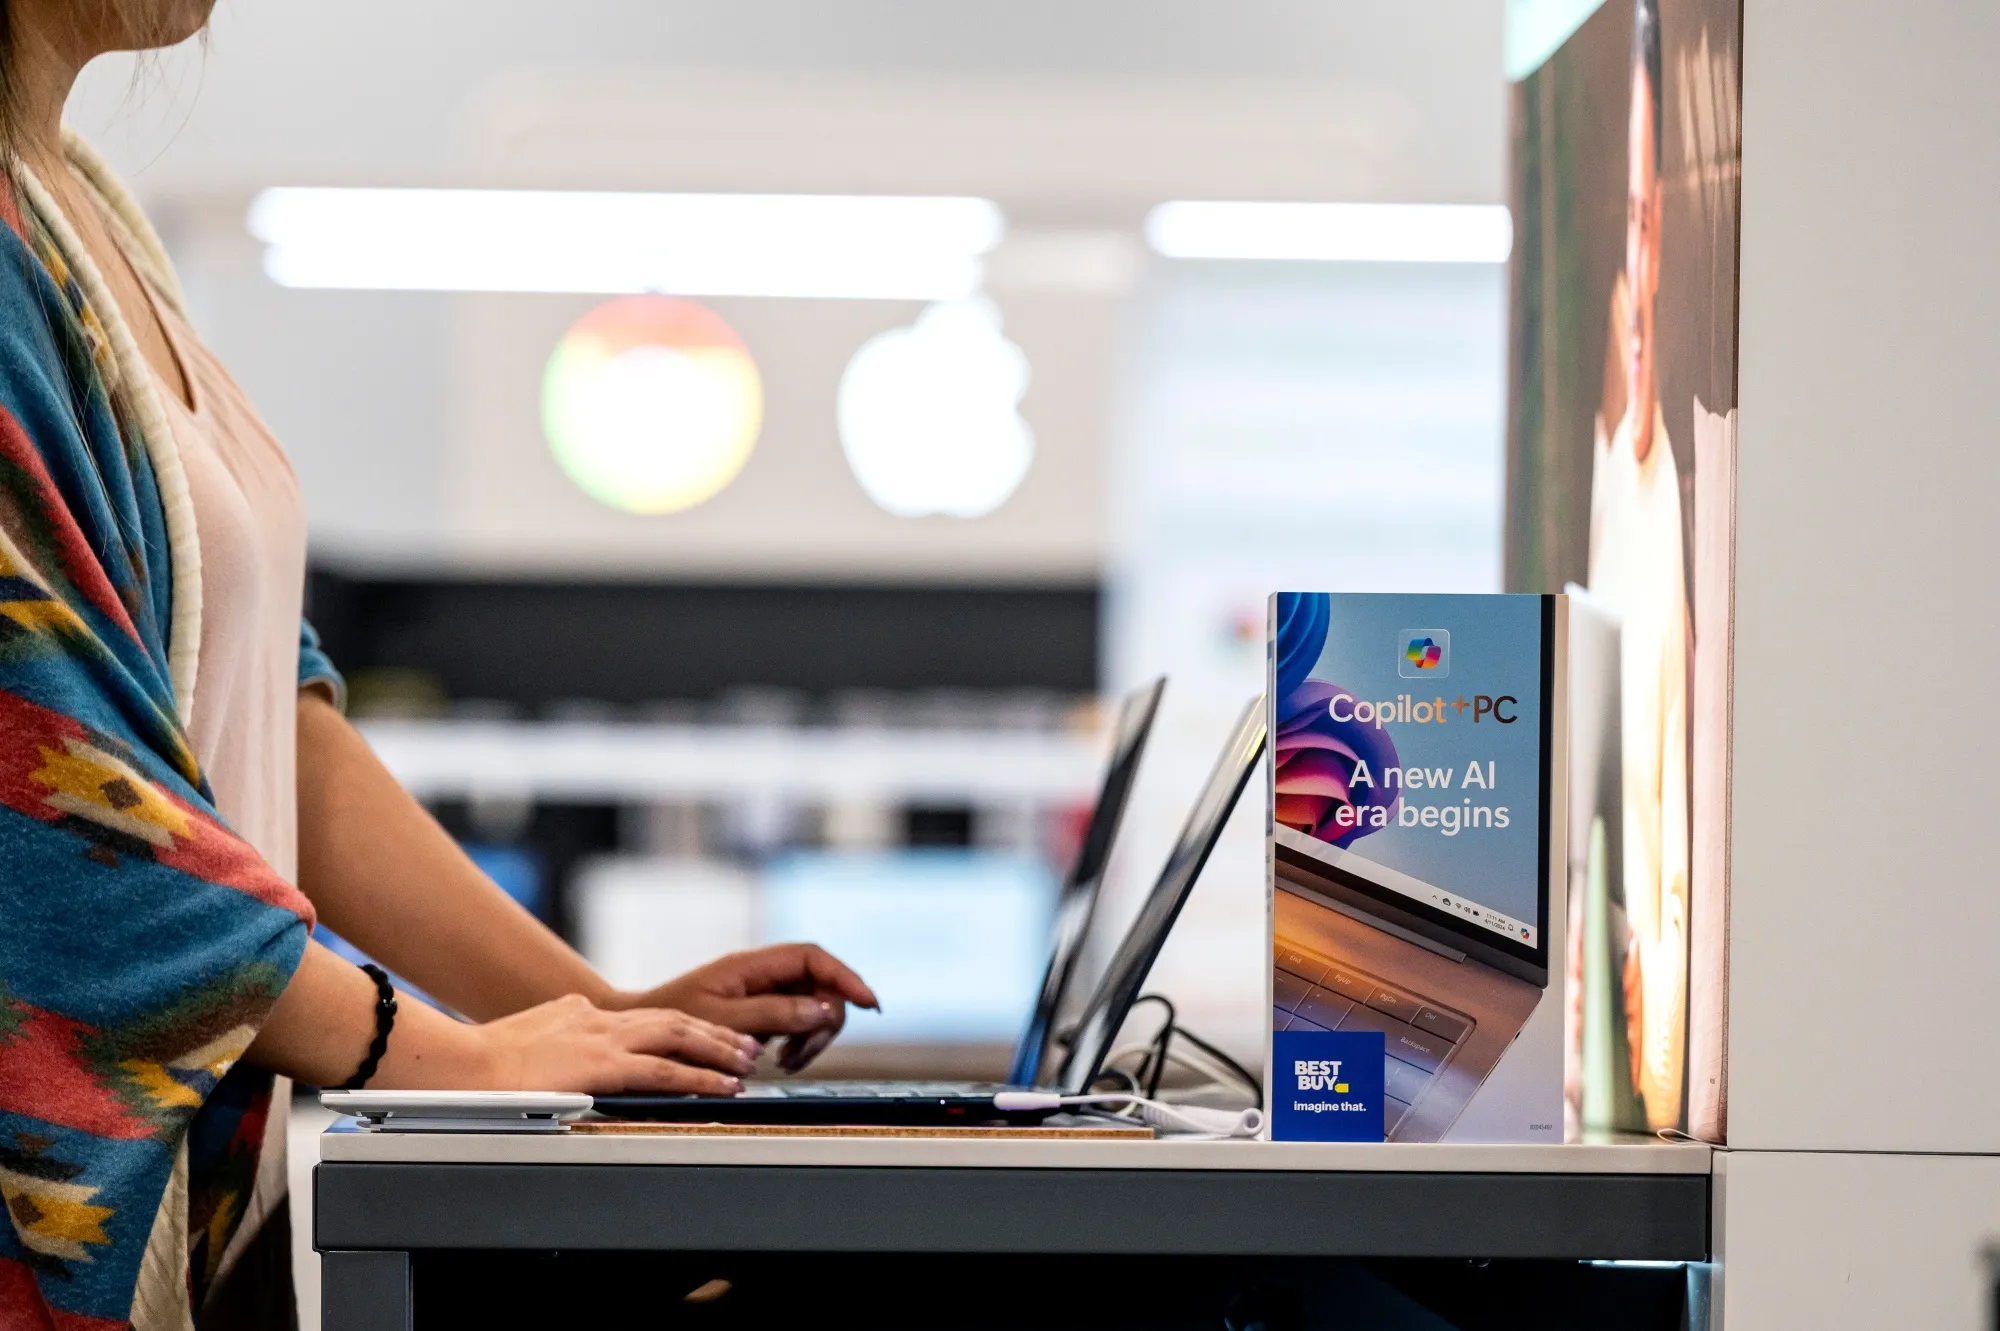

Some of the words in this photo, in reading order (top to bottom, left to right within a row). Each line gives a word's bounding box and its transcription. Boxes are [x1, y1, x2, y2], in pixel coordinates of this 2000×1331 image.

[1348, 759, 1374, 788] A
[1384, 766, 1453, 789] new
[1461, 760, 1495, 789] AI
[1335, 804, 1388, 827] era
[1399, 798, 1510, 836] begins
[1289, 955, 1301, 964] End
[1335, 974, 1351, 985] PgUp
[1379, 993, 1397, 1005] PgDn
[1424, 1011, 1437, 1021] Del
[1400, 1036, 1431, 1053] Backspace
[1294, 1060, 1342, 1075] BEST
[1298, 1075, 1338, 1090] BUY
[1293, 1101, 1339, 1113] imagine
[1341, 1101, 1367, 1112] that.
